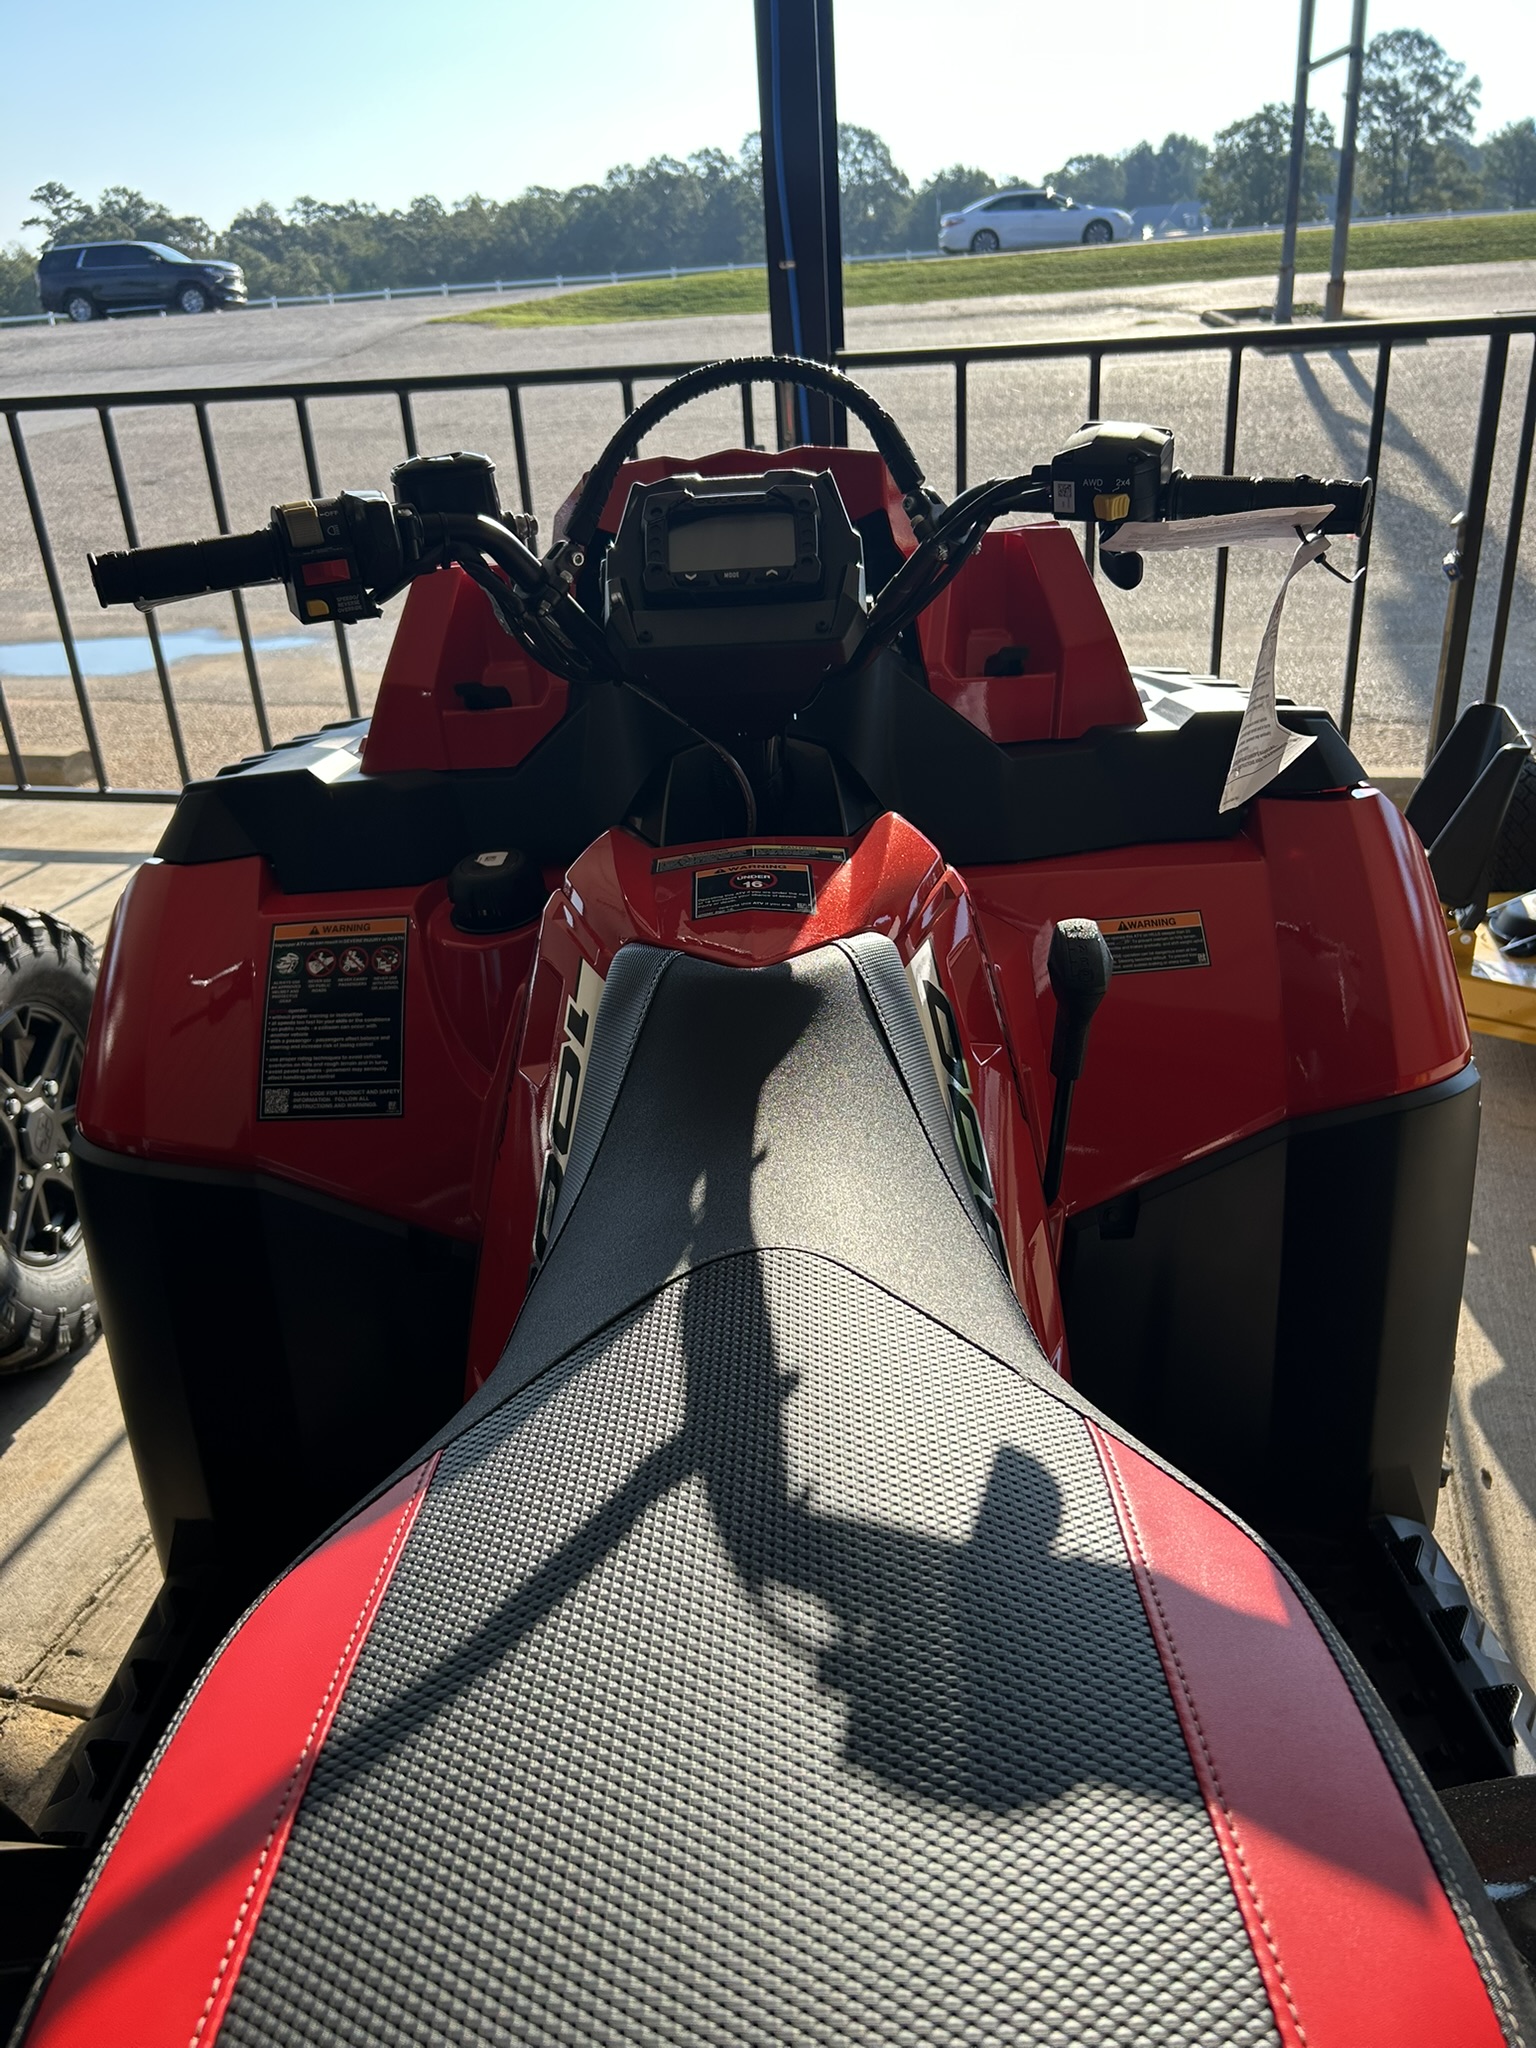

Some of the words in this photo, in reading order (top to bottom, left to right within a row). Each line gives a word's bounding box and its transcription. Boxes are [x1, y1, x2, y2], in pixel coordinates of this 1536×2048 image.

[1082, 479, 1103, 487] AWD
[1115, 478, 1131, 487] 2x4
[742, 880, 763, 888] 16
[1127, 917, 1177, 929] WARNING
[322, 923, 371, 933] WARNING
